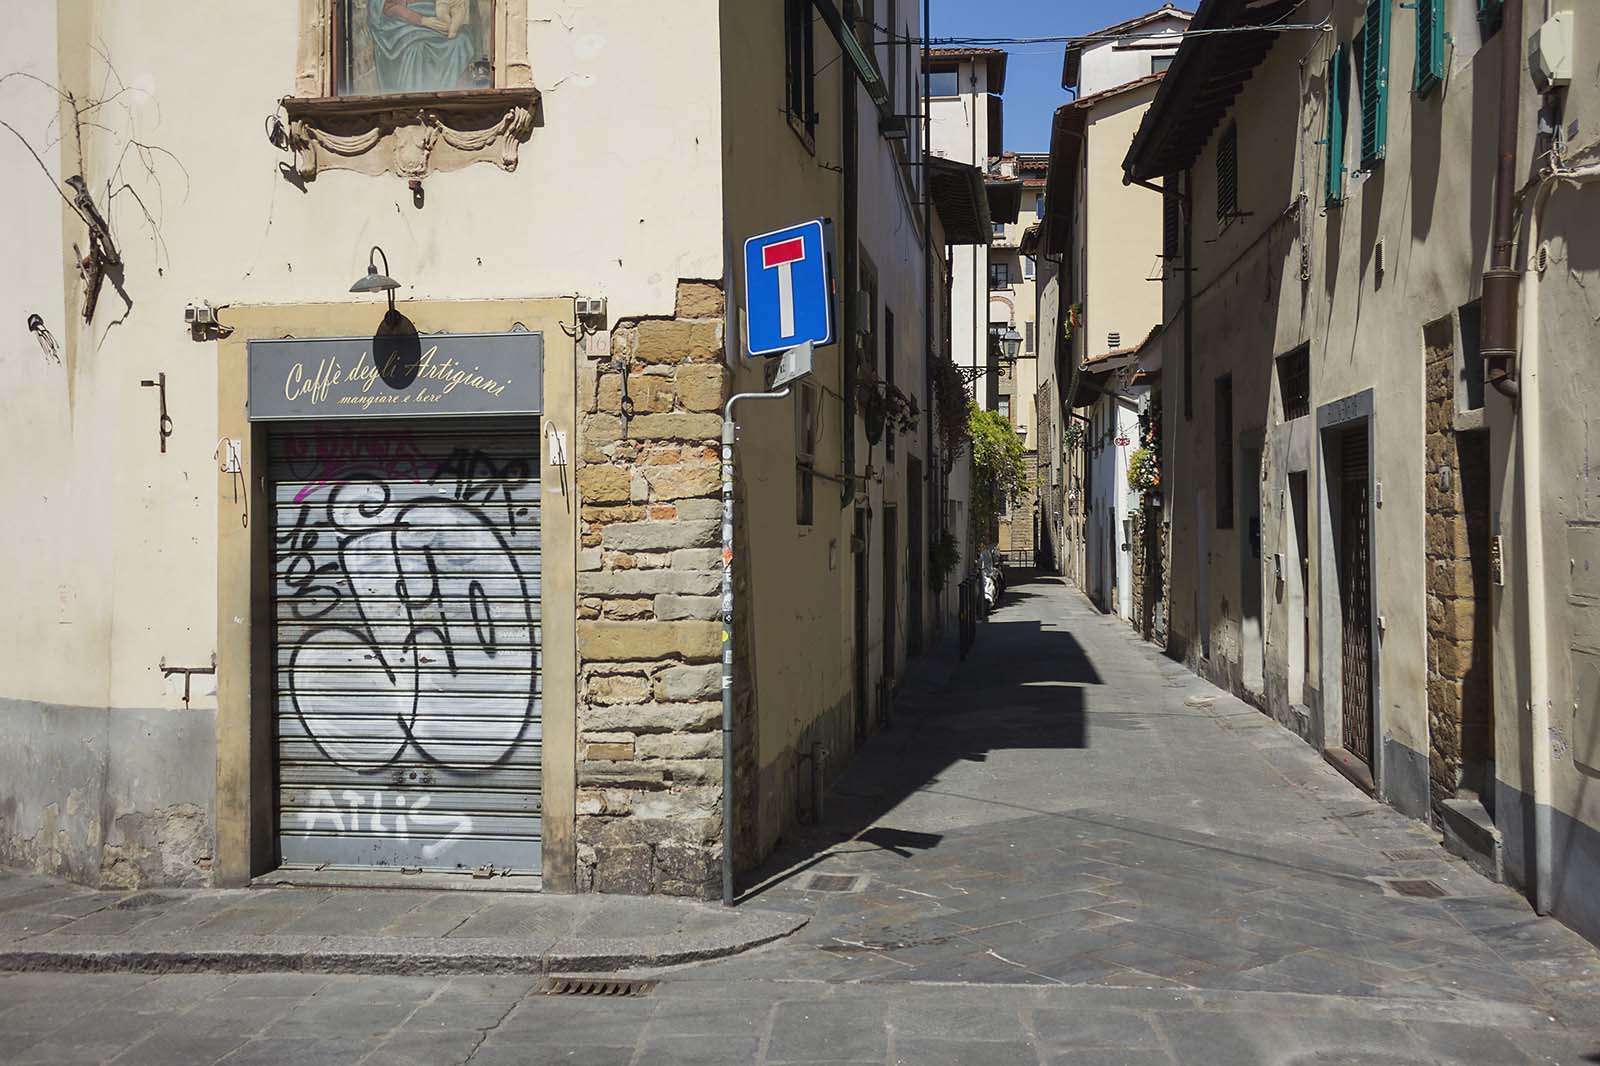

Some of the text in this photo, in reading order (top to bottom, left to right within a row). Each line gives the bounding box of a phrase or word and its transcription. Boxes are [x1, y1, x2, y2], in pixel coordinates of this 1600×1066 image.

[285, 345, 512, 405] Caffè degli Artigiani
[338, 387, 442, 410] mangiare e bere
